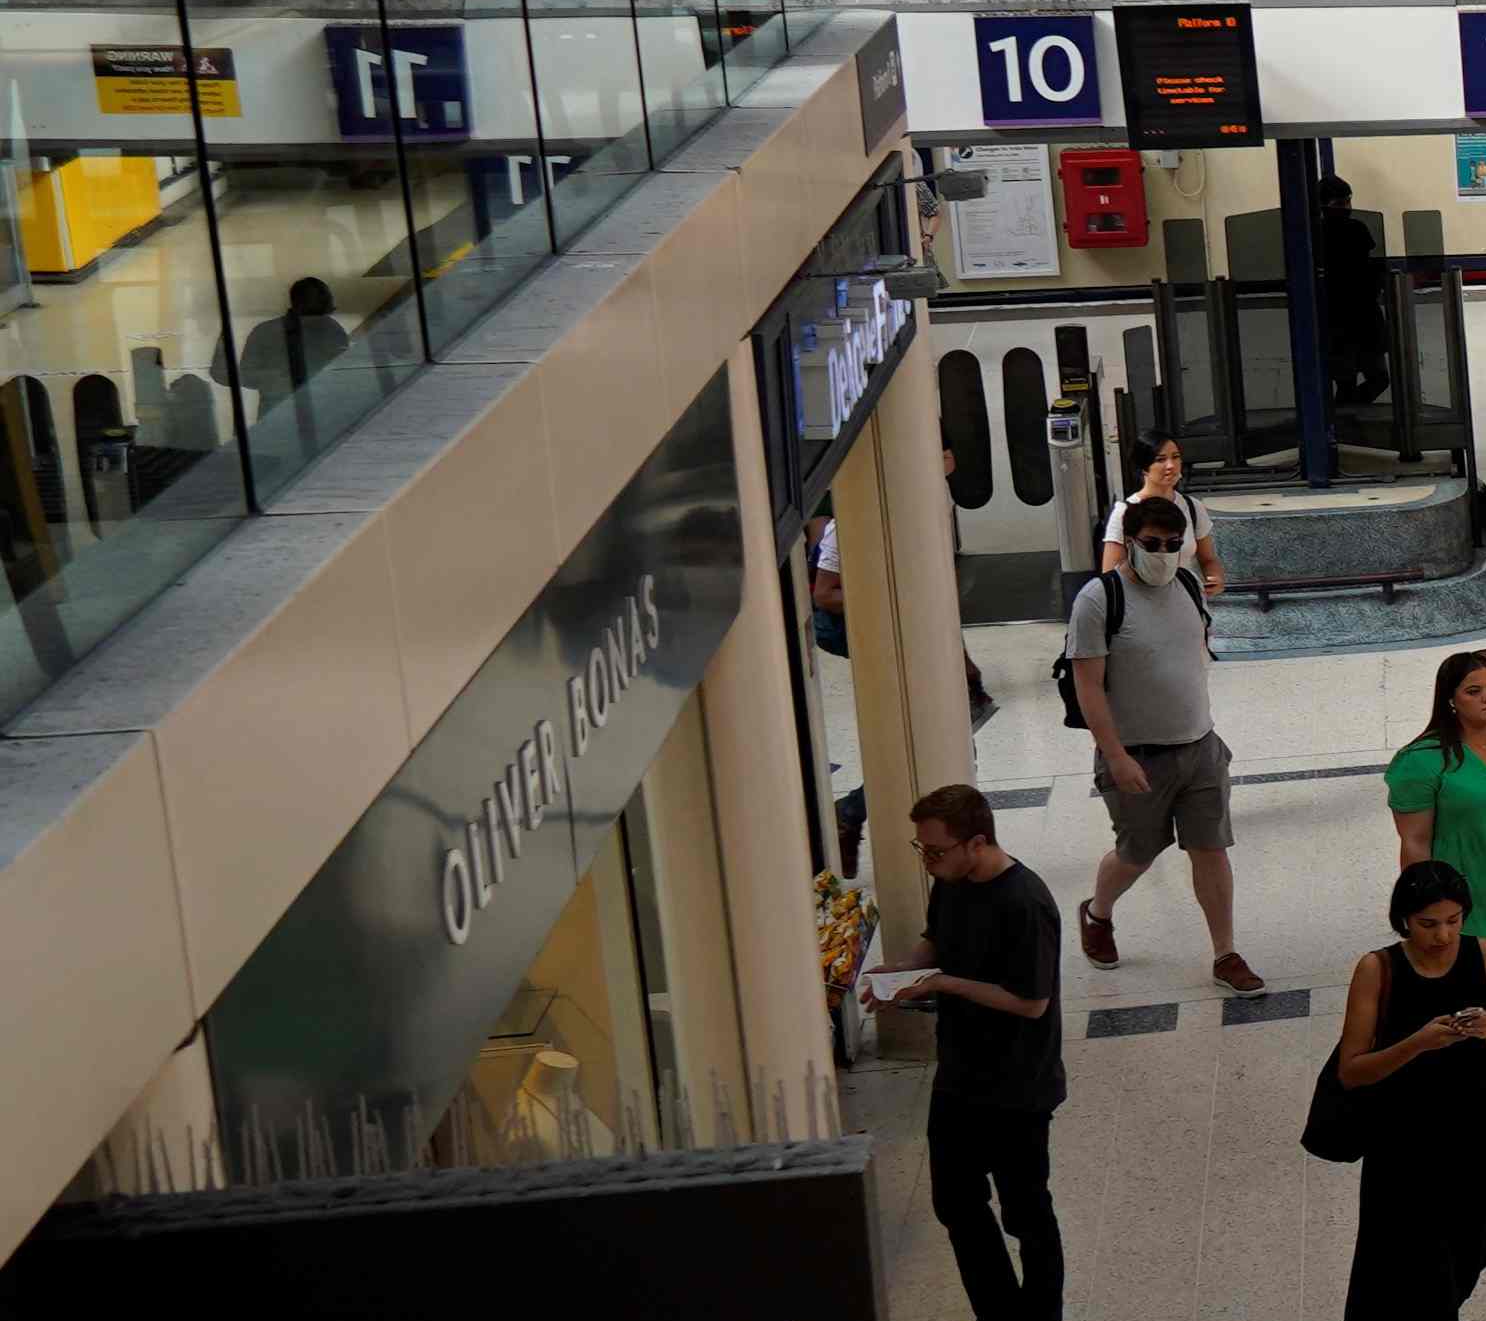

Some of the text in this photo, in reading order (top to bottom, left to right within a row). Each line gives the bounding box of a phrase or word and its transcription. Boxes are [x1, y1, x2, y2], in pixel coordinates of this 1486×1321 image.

[989, 35, 1084, 102] 10
[443, 574, 659, 945] OLIVER BONAS
